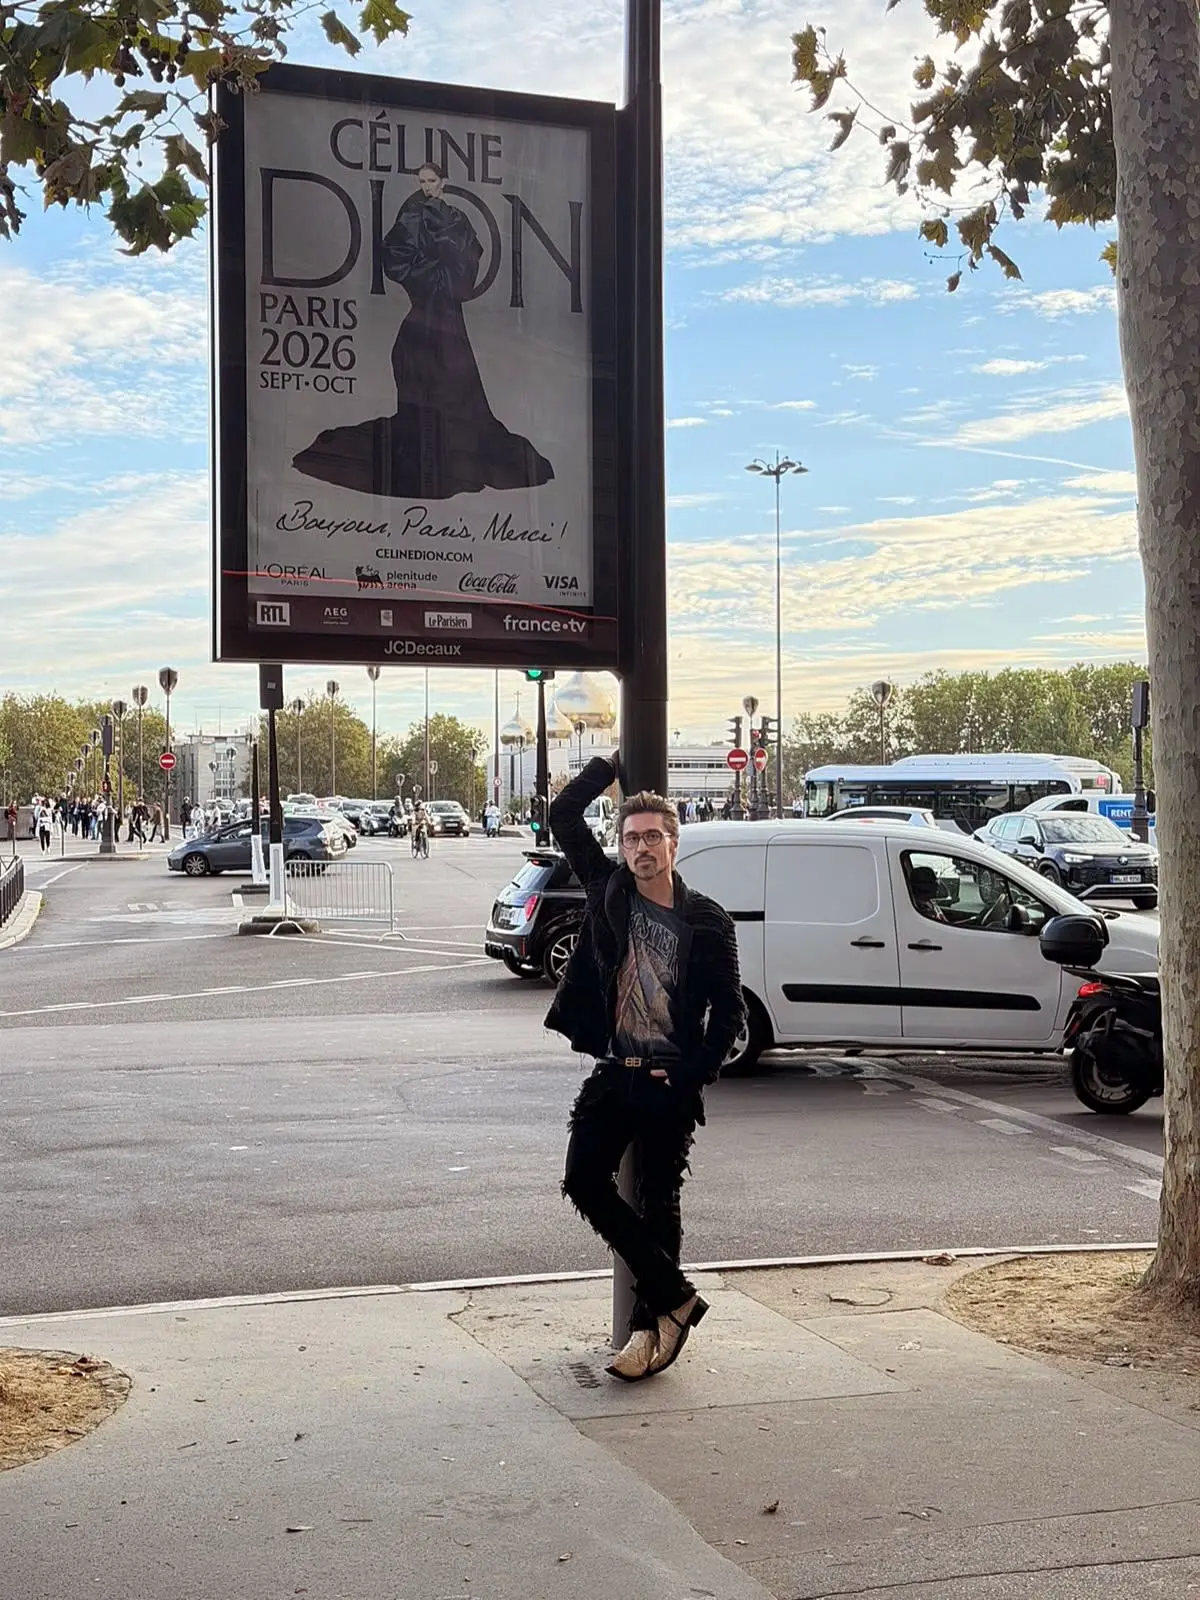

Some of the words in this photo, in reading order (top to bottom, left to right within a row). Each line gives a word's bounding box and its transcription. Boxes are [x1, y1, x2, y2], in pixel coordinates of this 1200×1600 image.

[330, 110, 503, 185] CÉLINE
[259, 167, 583, 313] DION
[259, 293, 358, 330] PARIS
[259, 328, 357, 371] 2026
[375, 548, 473, 563] CELINEDION.COM
[256, 563, 333, 580] L'ORÉAL
[386, 569, 438, 582] plenitude
[281, 579, 309, 587] PARIS
[387, 581, 417, 589] arena
[542, 576, 579, 590] VISA
[260, 605, 287, 623] RTL
[324, 607, 348, 617] AEG
[384, 641, 461, 656] JCDecaux
[1111, 809, 1132, 817] RENT
